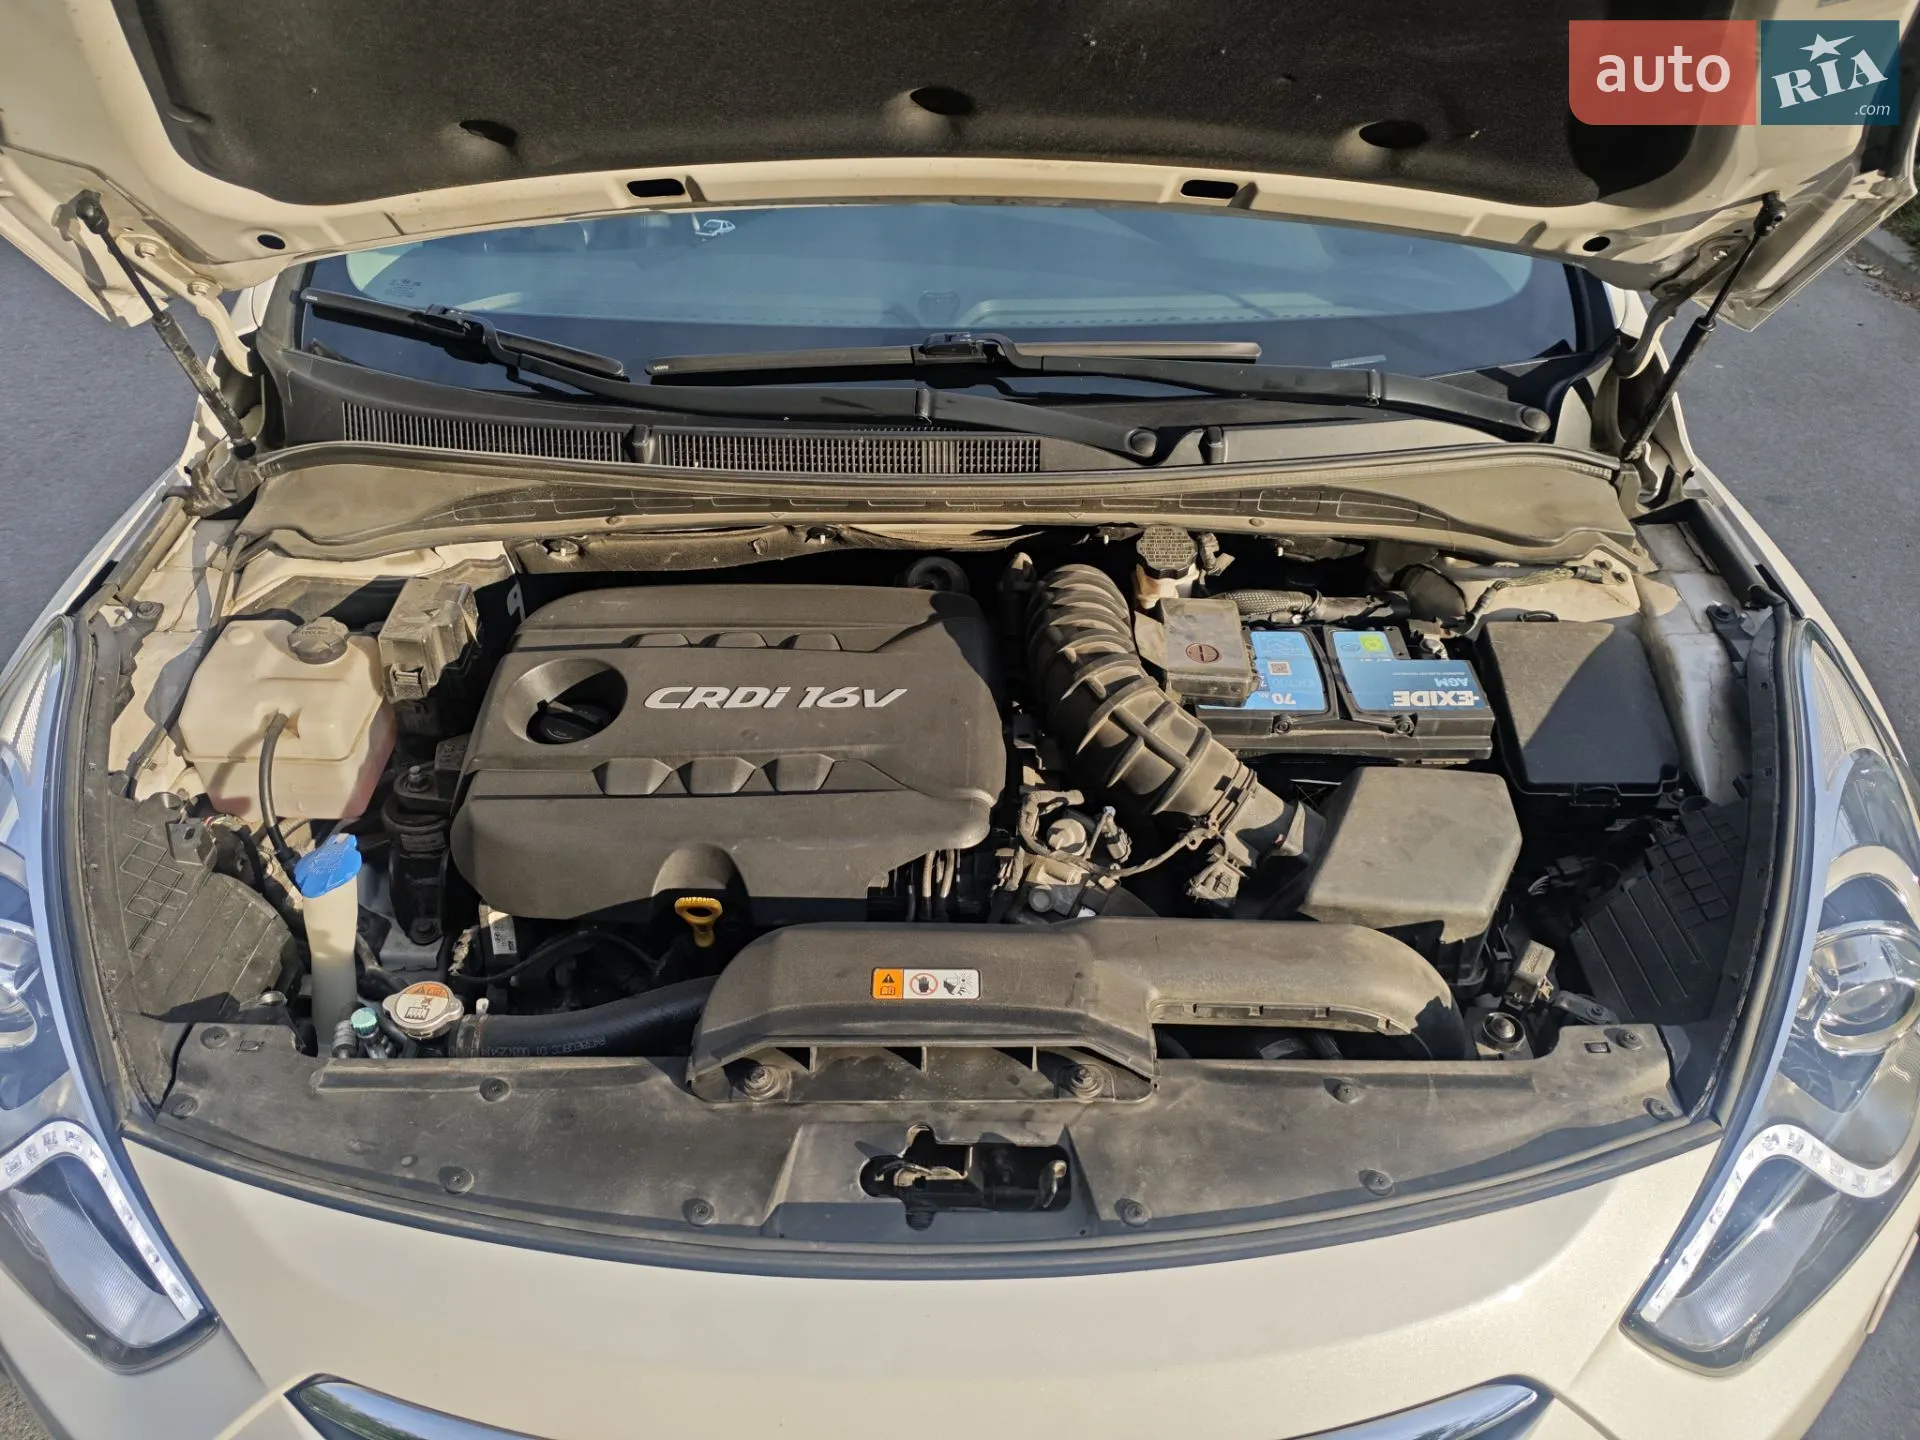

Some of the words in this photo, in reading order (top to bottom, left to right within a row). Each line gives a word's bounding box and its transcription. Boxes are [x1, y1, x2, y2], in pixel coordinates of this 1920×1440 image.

[1434, 677, 1469, 687] AGM
[644, 686, 791, 709] CRDi
[798, 686, 908, 709] 16V
[1271, 692, 1297, 705] 70
[1392, 690, 1480, 708] EXIDE
